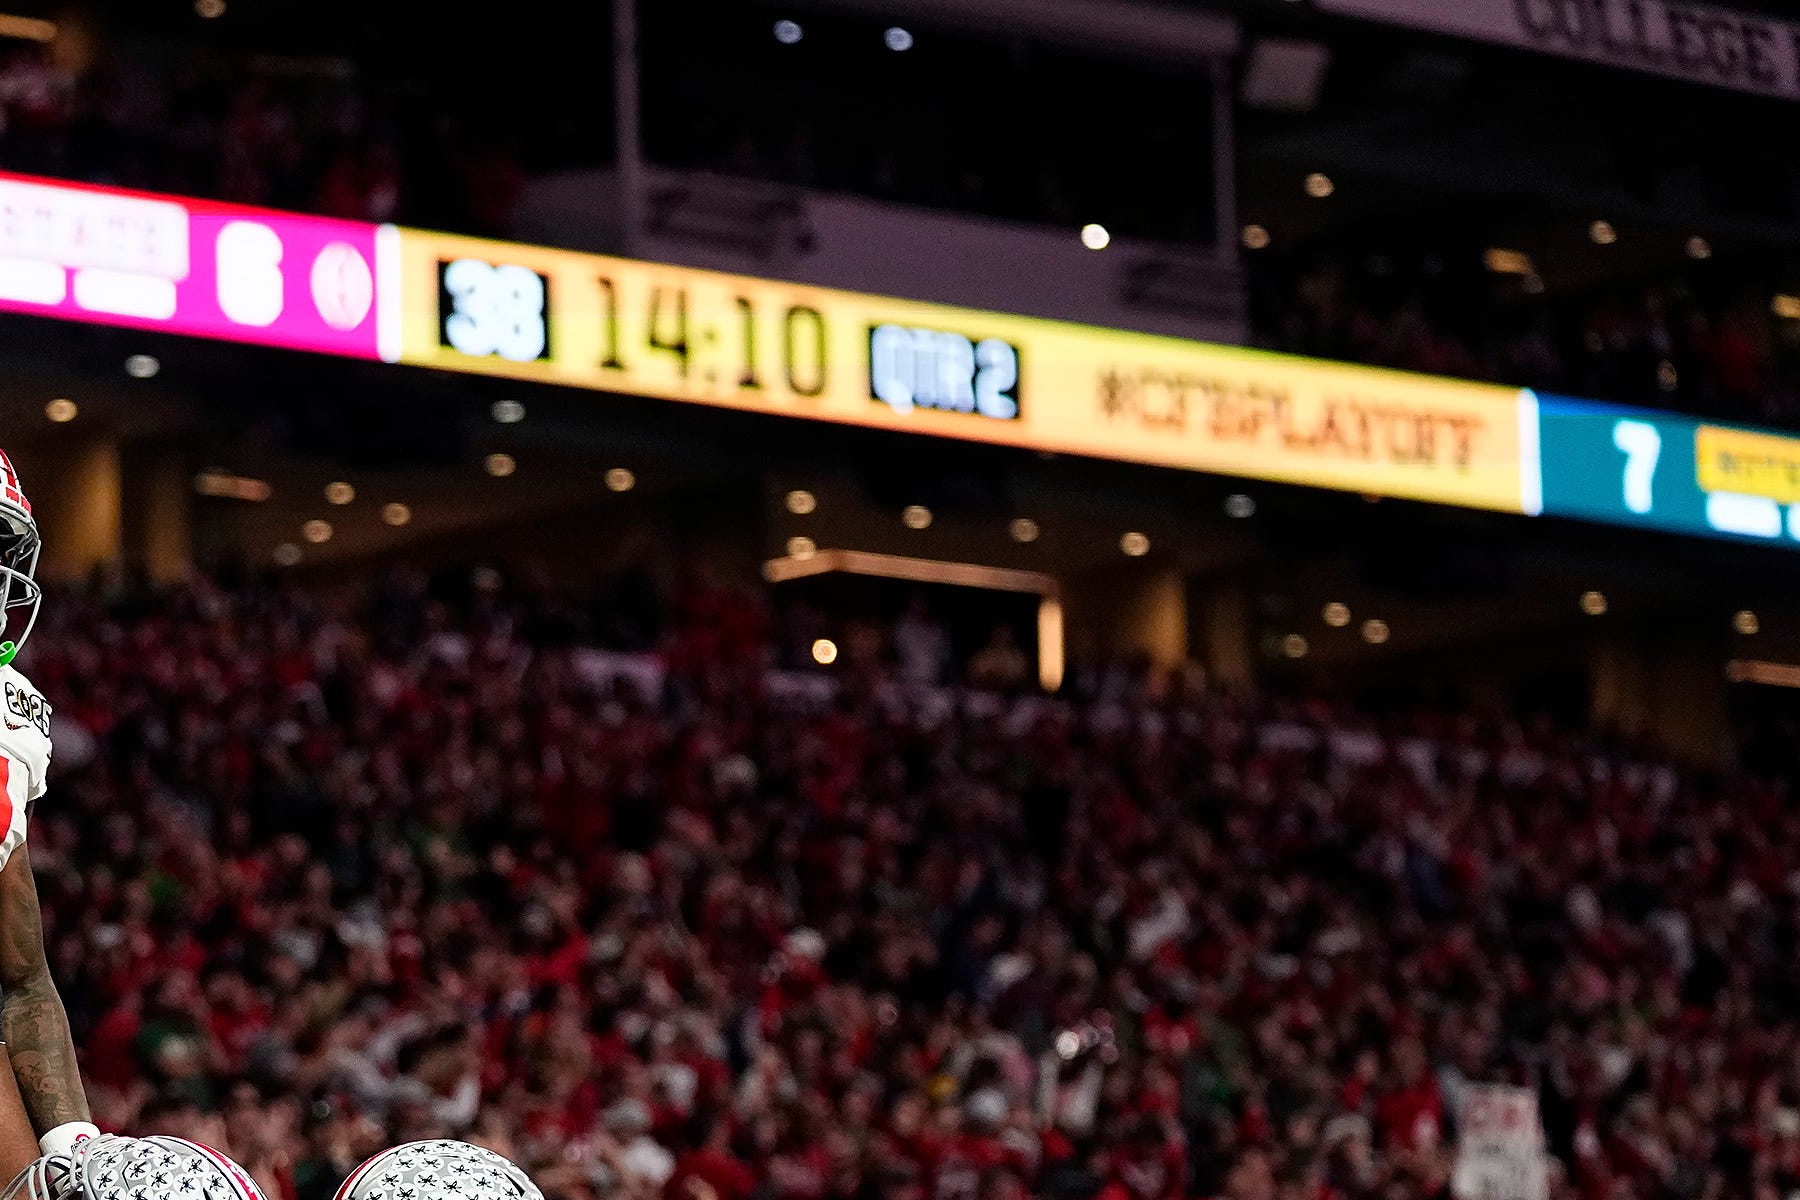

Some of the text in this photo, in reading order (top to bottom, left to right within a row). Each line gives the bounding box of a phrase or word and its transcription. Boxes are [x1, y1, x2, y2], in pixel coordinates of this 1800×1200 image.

[215, 221, 284, 327] 6
[597, 277, 827, 397] 14:10
[1613, 419, 1662, 515] 7
[4, 681, 53, 738] 2025
